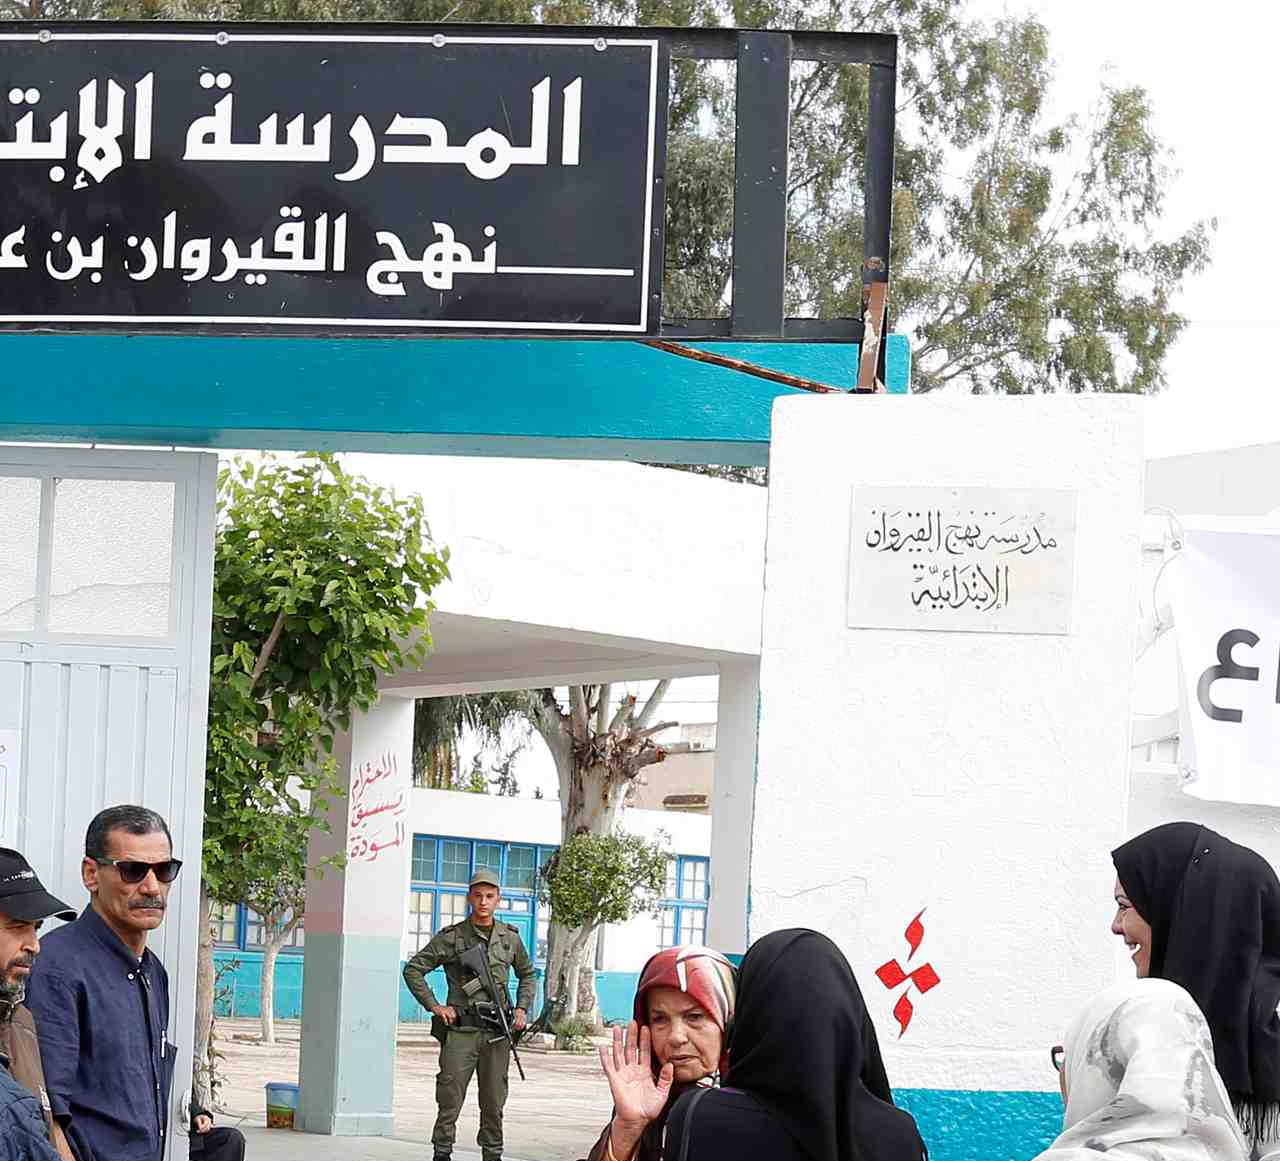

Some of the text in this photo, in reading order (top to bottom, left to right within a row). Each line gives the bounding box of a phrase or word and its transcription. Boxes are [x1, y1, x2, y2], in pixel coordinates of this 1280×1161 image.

[183, 72, 582, 182] المدرسة
[46, 231, 104, 283] بن
[124, 206, 347, 285] القيروان
[366, 221, 497, 296] نهج
